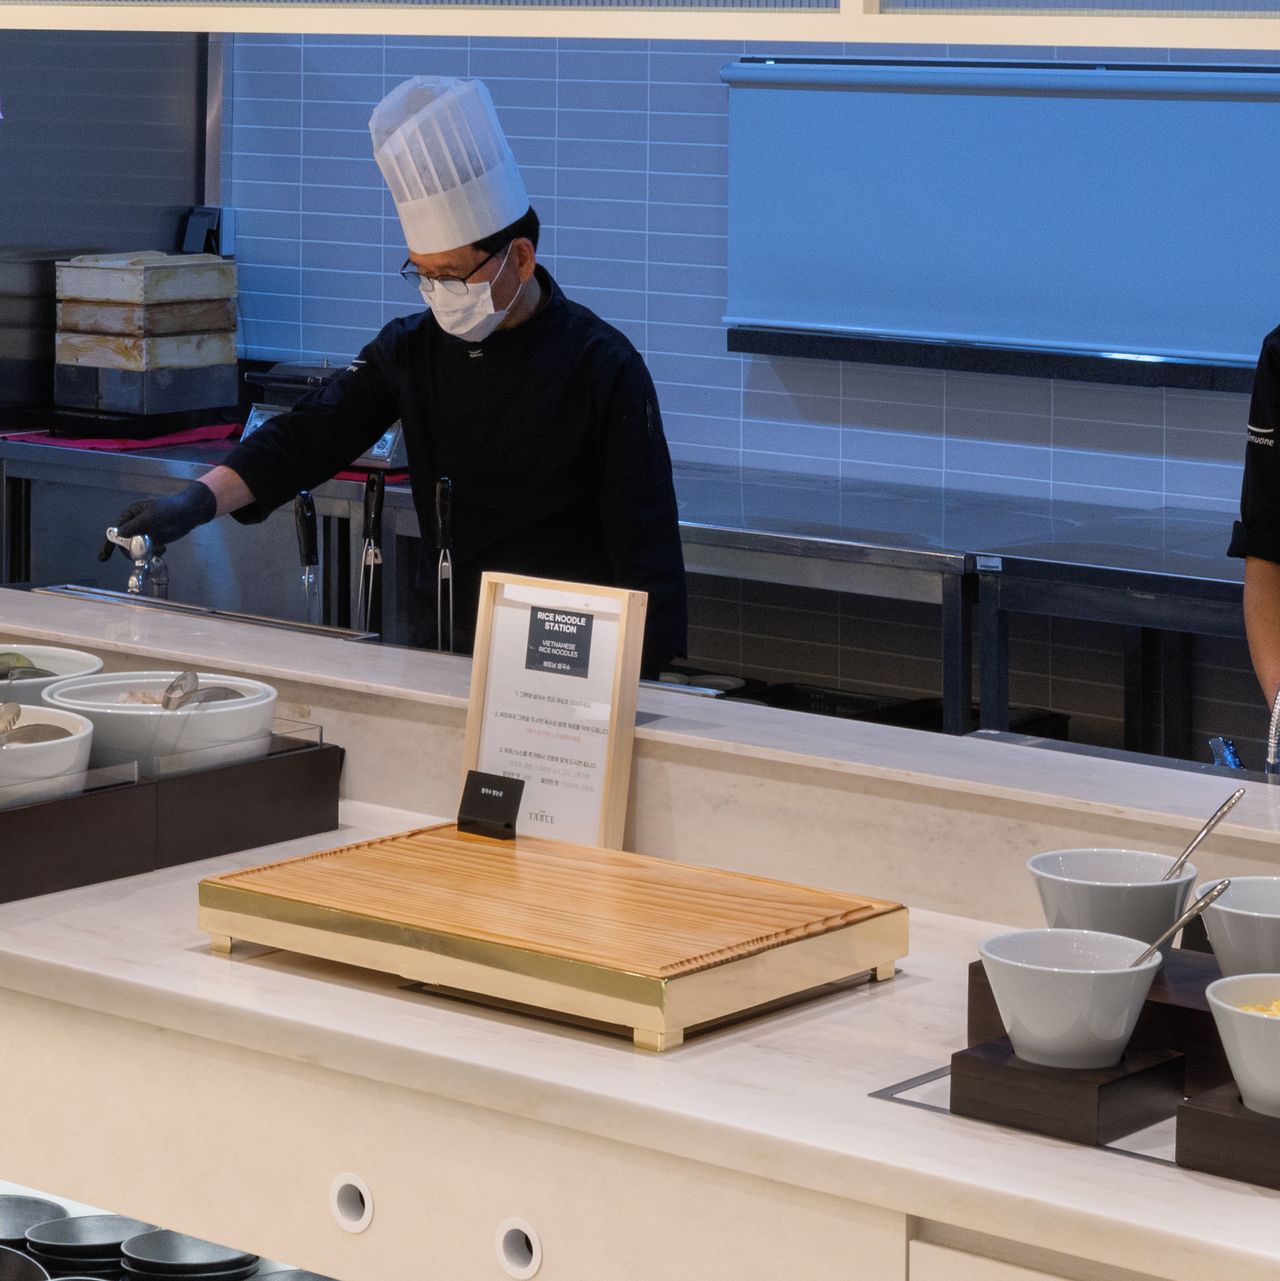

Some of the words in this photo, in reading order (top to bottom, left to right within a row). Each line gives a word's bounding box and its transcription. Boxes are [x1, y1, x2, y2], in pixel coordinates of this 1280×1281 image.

[537, 611, 555, 622] RICE
[555, 614, 587, 626] NOODLE
[544, 622, 577, 634] STATION
[542, 640, 576, 651] VIETNAMESE
[538, 646, 551, 654] RICE
[551, 648, 578, 658] NOODLES
[528, 812, 555, 825] TABLE
